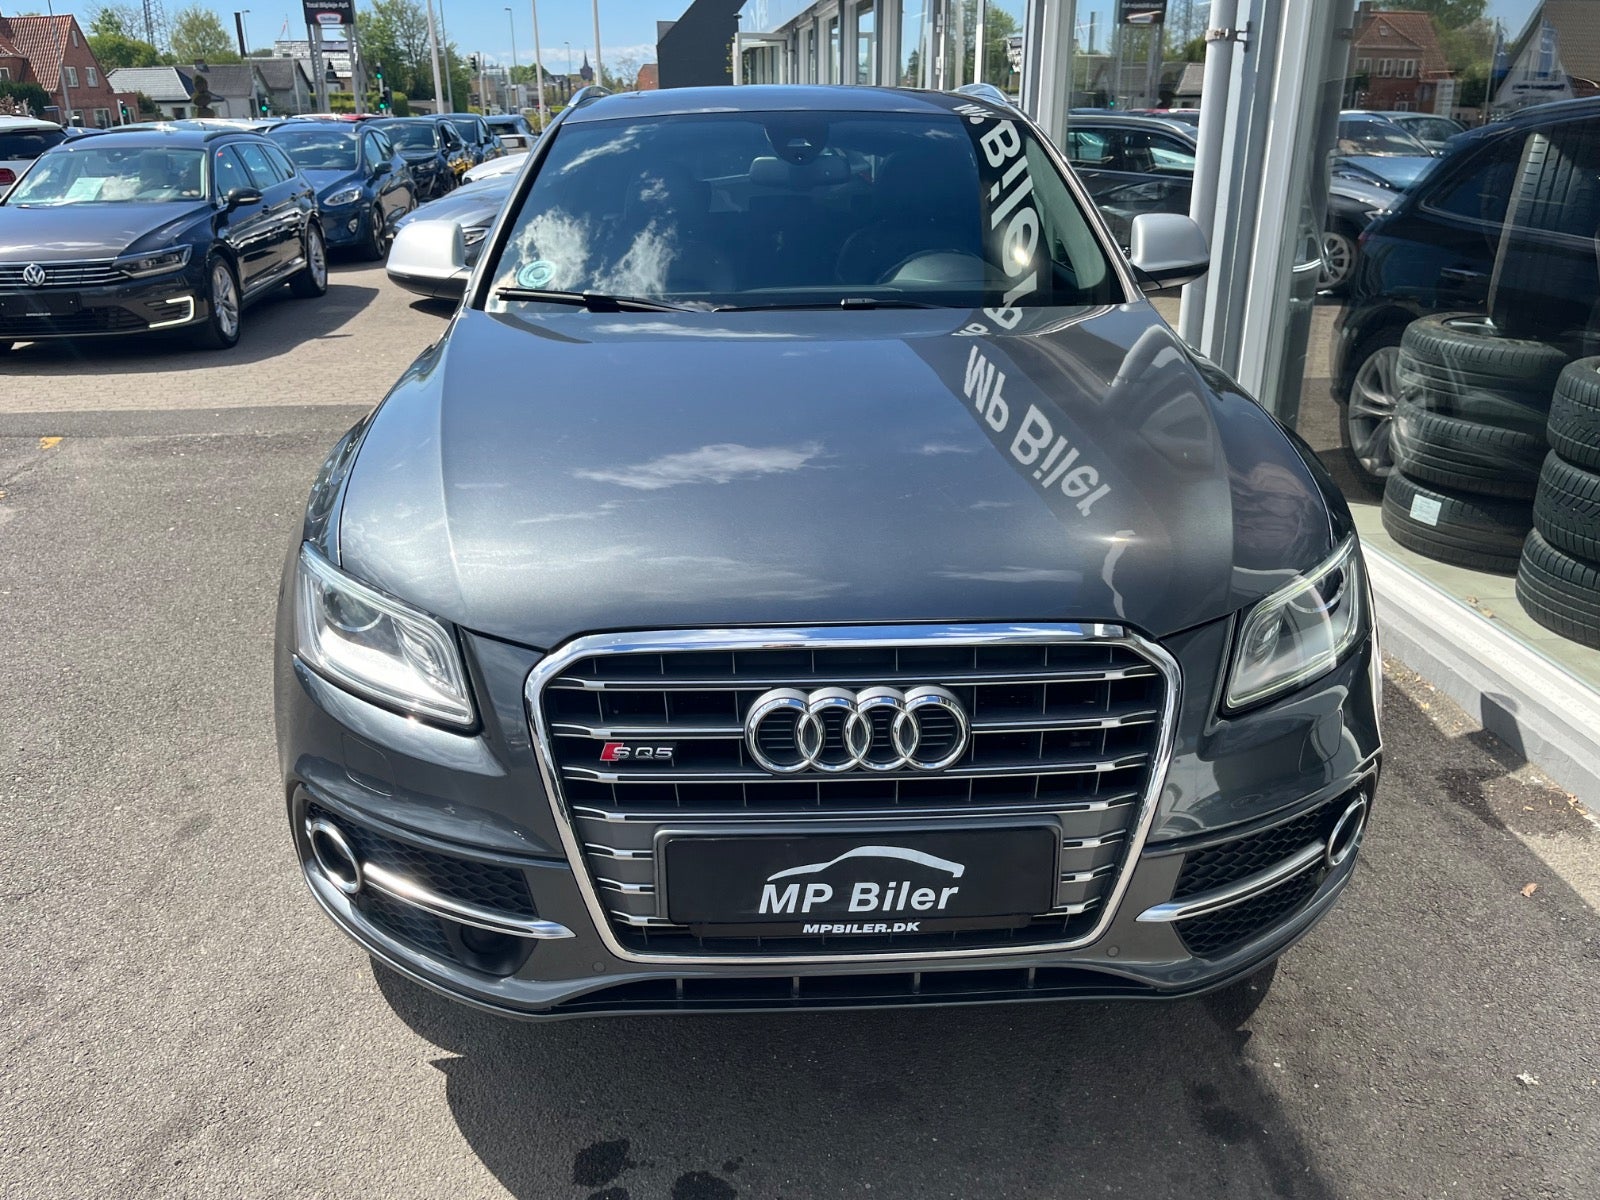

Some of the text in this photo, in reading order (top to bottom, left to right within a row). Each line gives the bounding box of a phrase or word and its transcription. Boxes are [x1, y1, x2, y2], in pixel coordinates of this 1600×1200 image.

[610, 746, 674, 760] SQ5
[758, 881, 959, 914] MP Biler
[802, 921, 921, 934] MPBILER.DK
